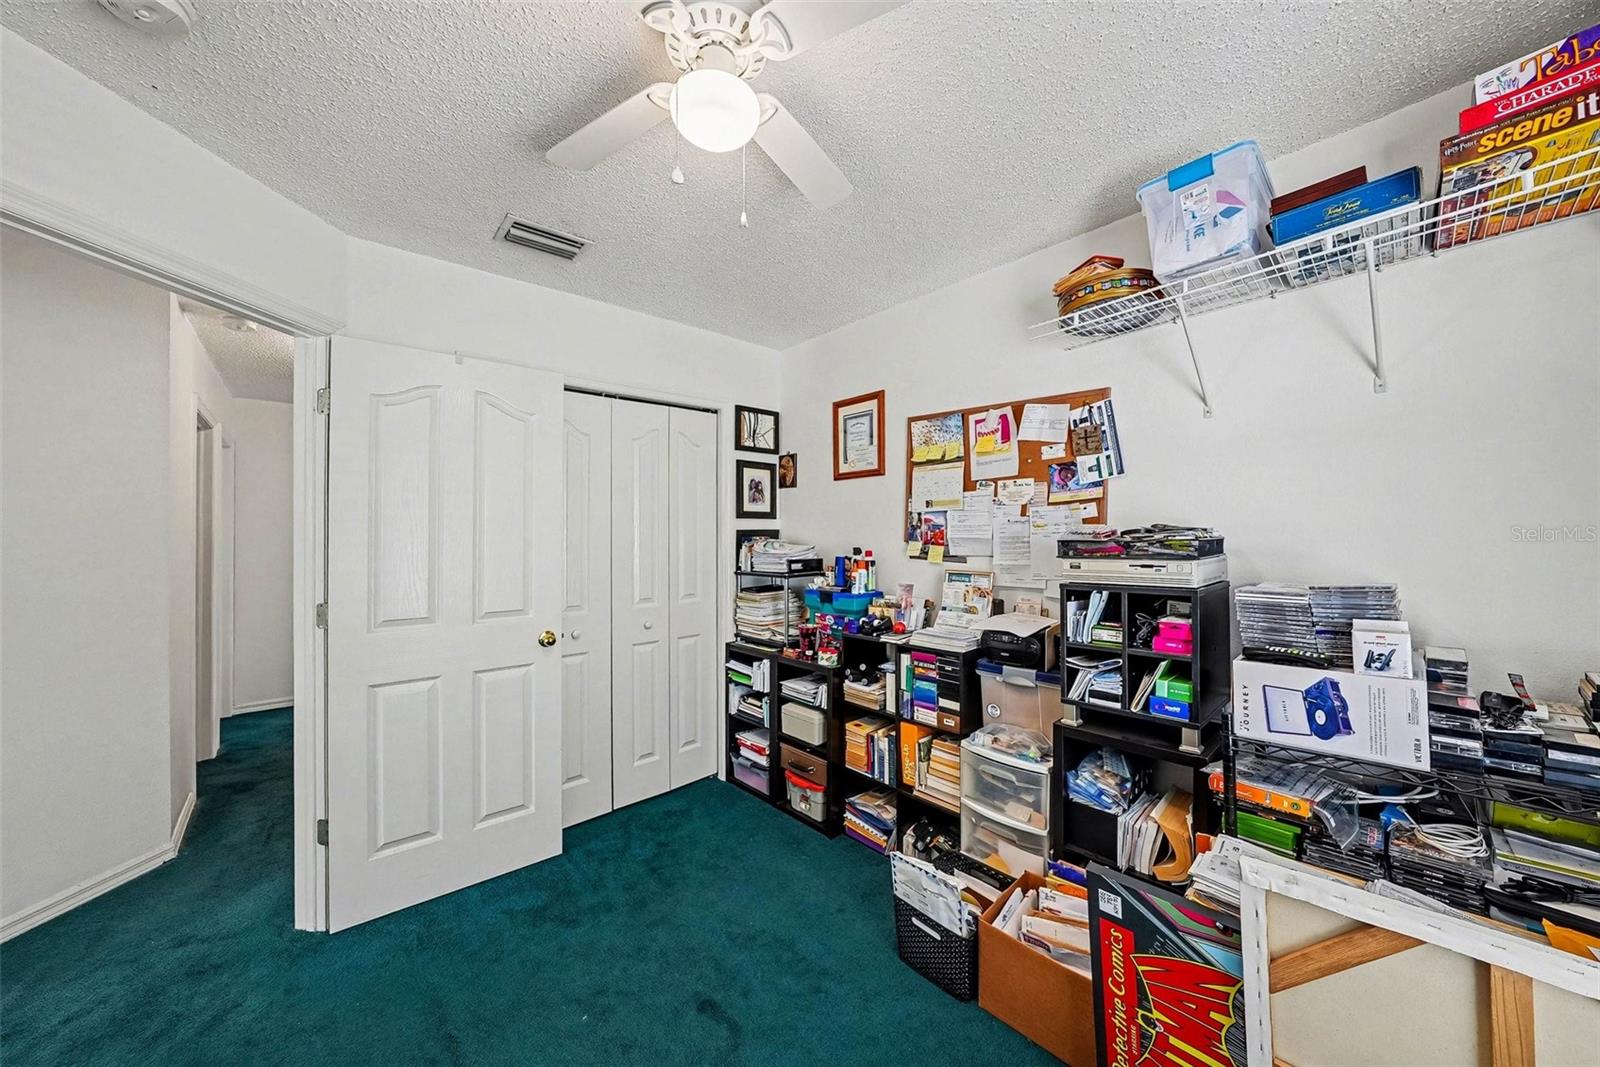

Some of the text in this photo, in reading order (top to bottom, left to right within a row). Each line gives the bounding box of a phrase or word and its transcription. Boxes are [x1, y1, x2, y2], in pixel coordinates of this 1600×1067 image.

[1477, 106, 1574, 154] scene
[1242, 684, 1250, 731] JOURNEY
[1105, 928, 1126, 996] Comics
